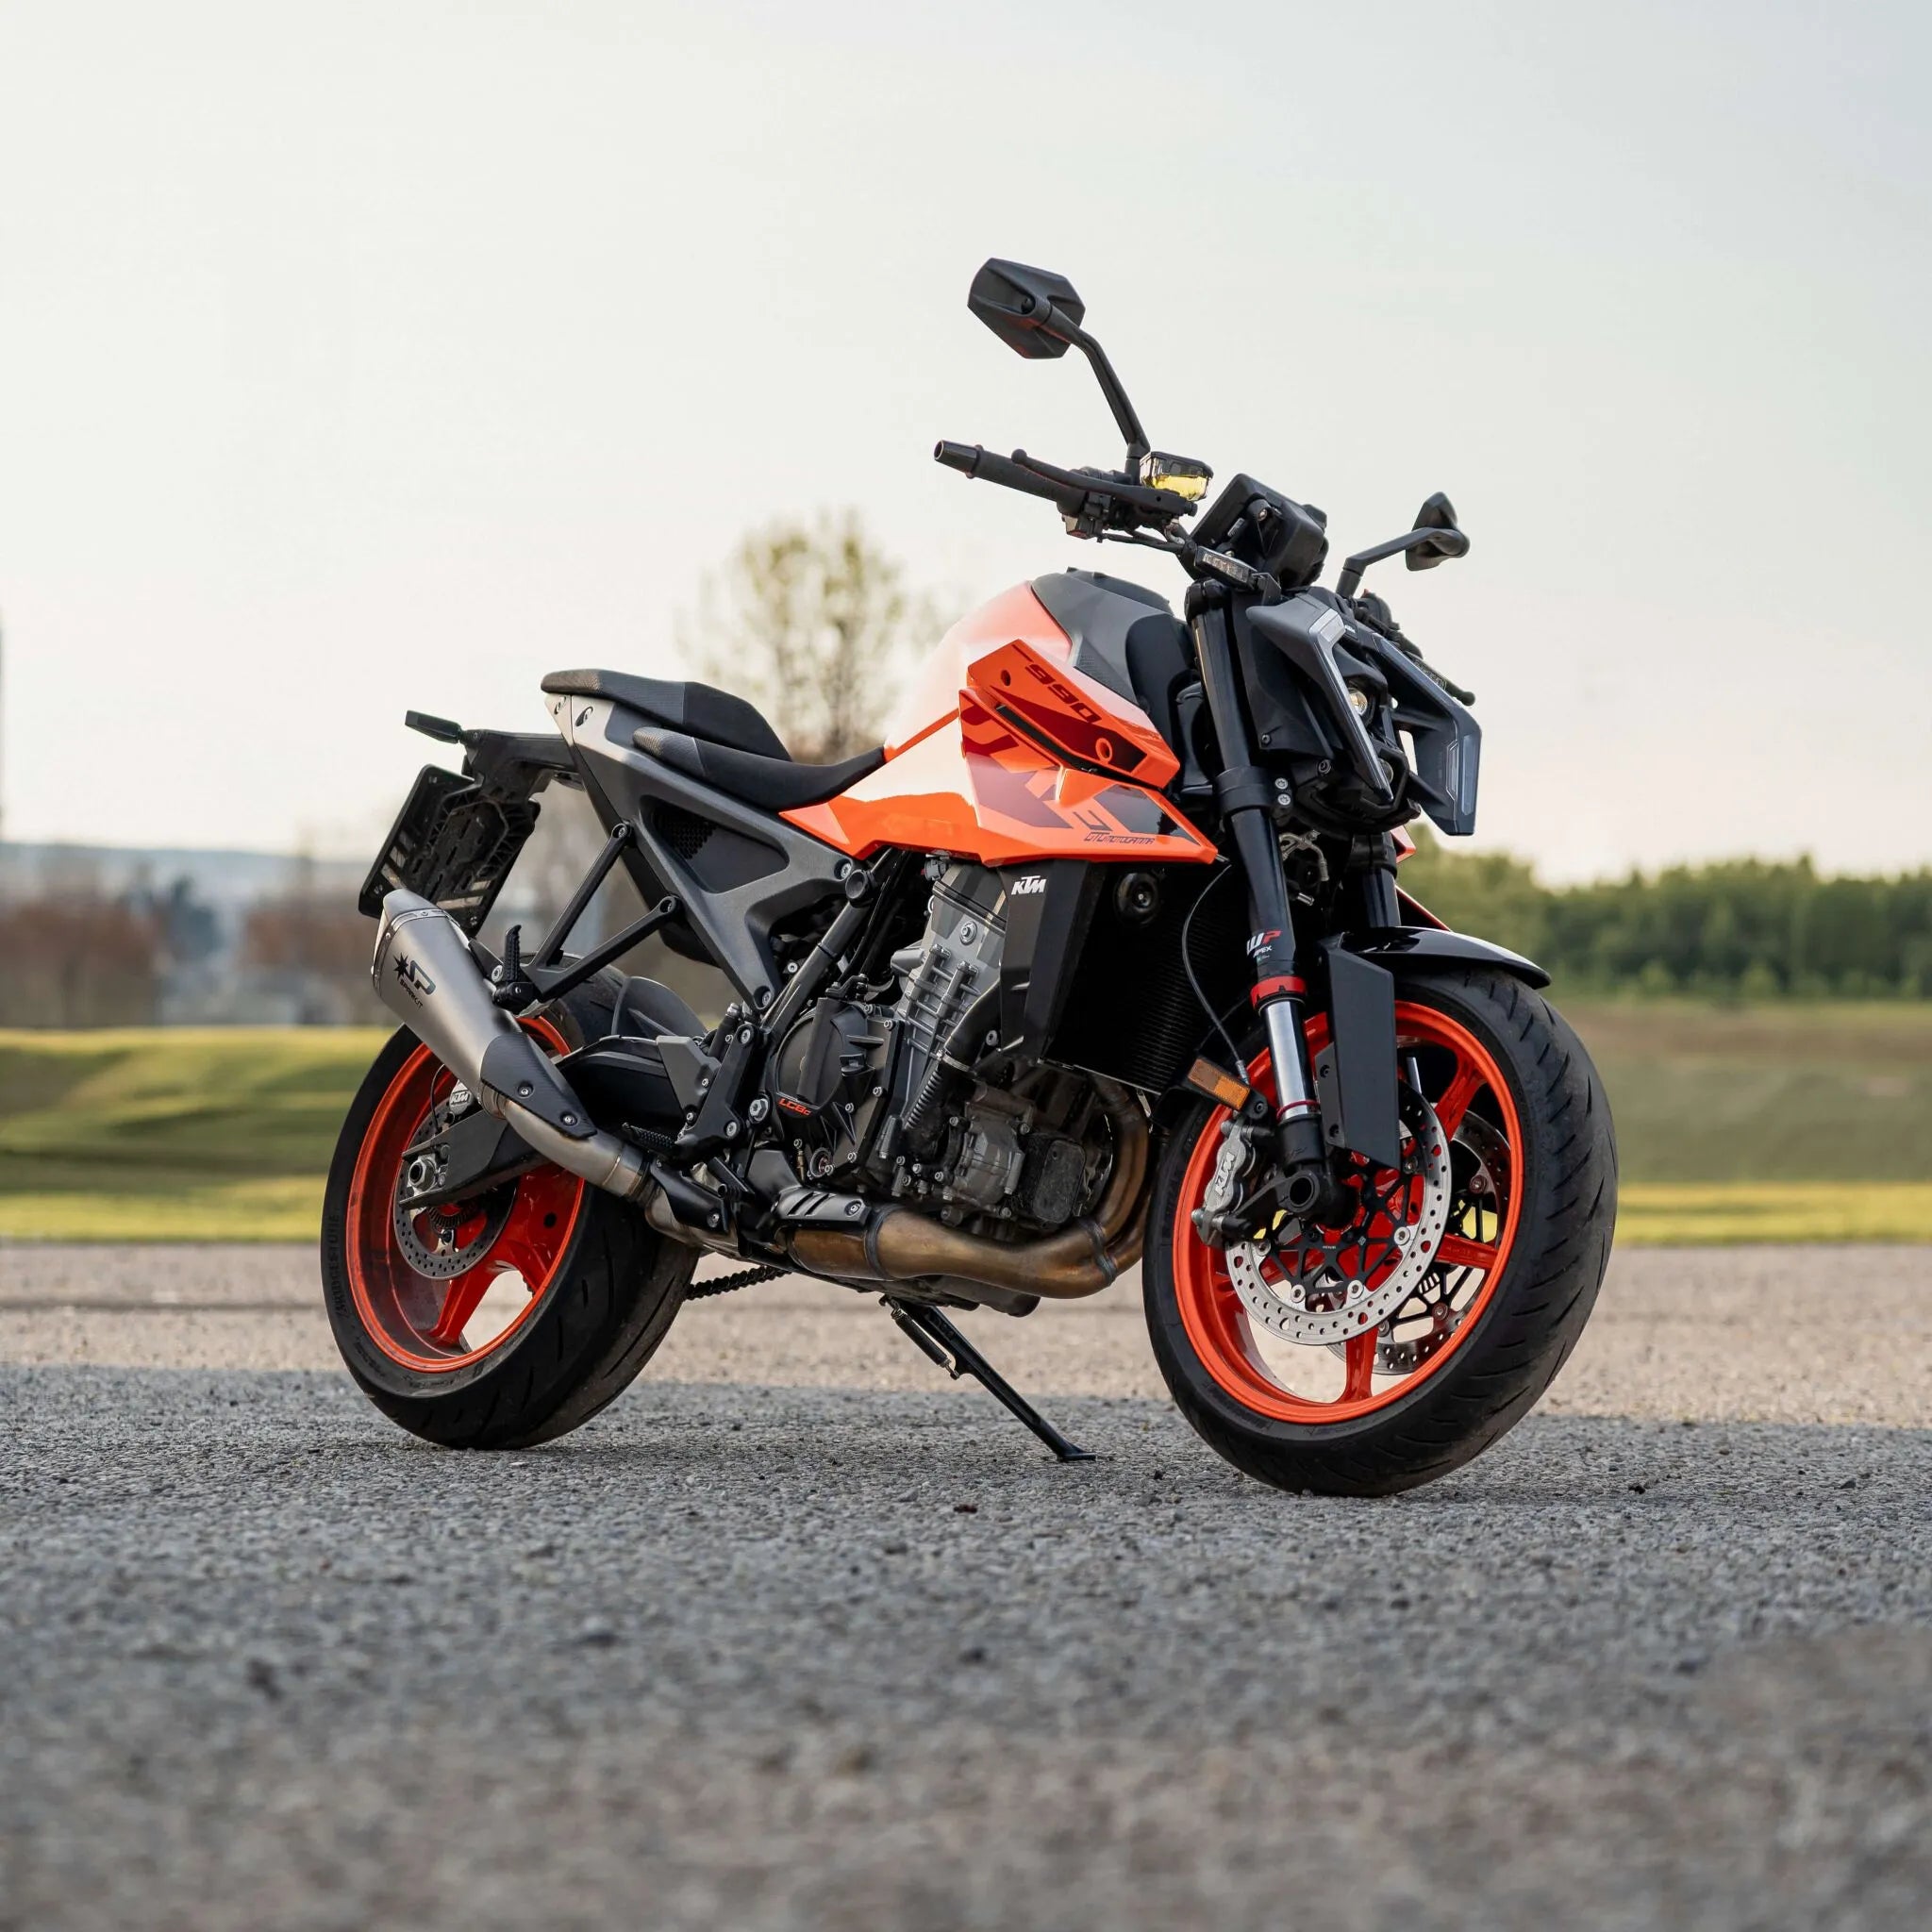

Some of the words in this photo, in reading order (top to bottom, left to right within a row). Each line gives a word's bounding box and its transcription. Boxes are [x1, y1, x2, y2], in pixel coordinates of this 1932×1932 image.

[1024, 663, 1102, 724] 990
[1010, 874, 1047, 895] KTM
[1246, 930, 1282, 956] WP
[1215, 1151, 1235, 1196] KTM
